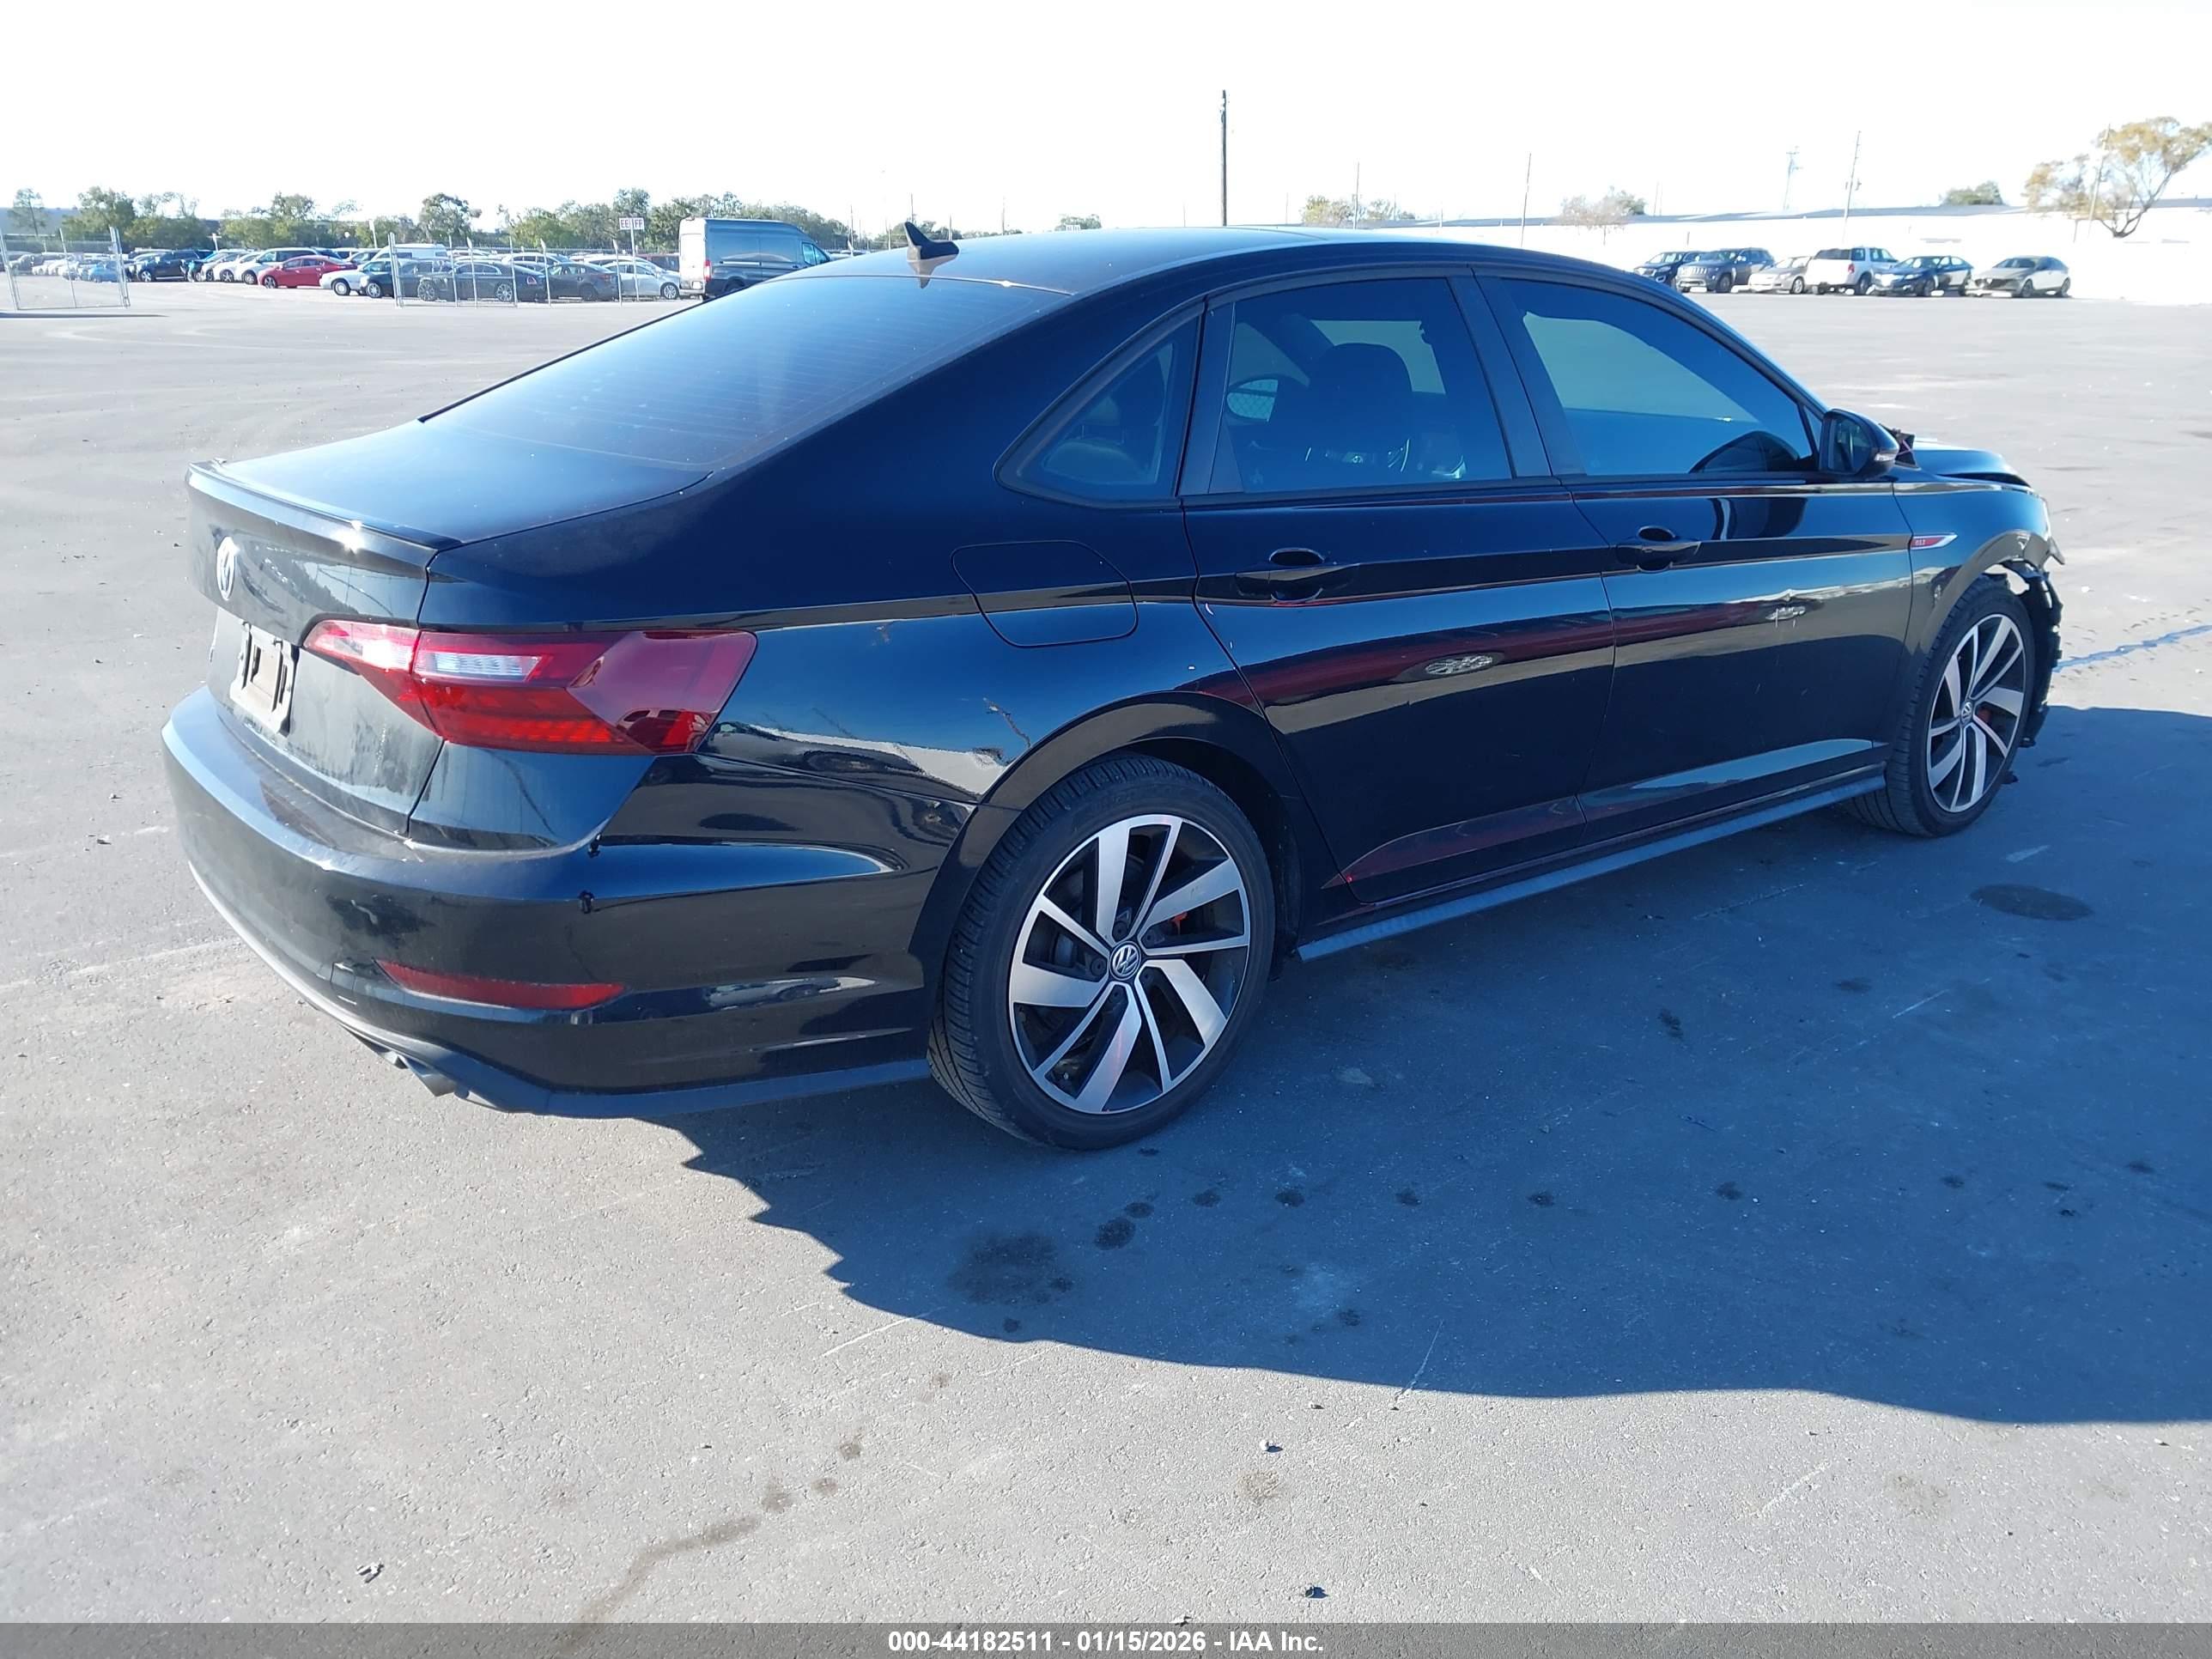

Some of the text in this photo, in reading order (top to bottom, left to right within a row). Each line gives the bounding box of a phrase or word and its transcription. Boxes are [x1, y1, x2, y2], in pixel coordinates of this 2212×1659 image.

[620, 219, 643, 228] EE FF
[1112, 945, 1139, 976] VW
